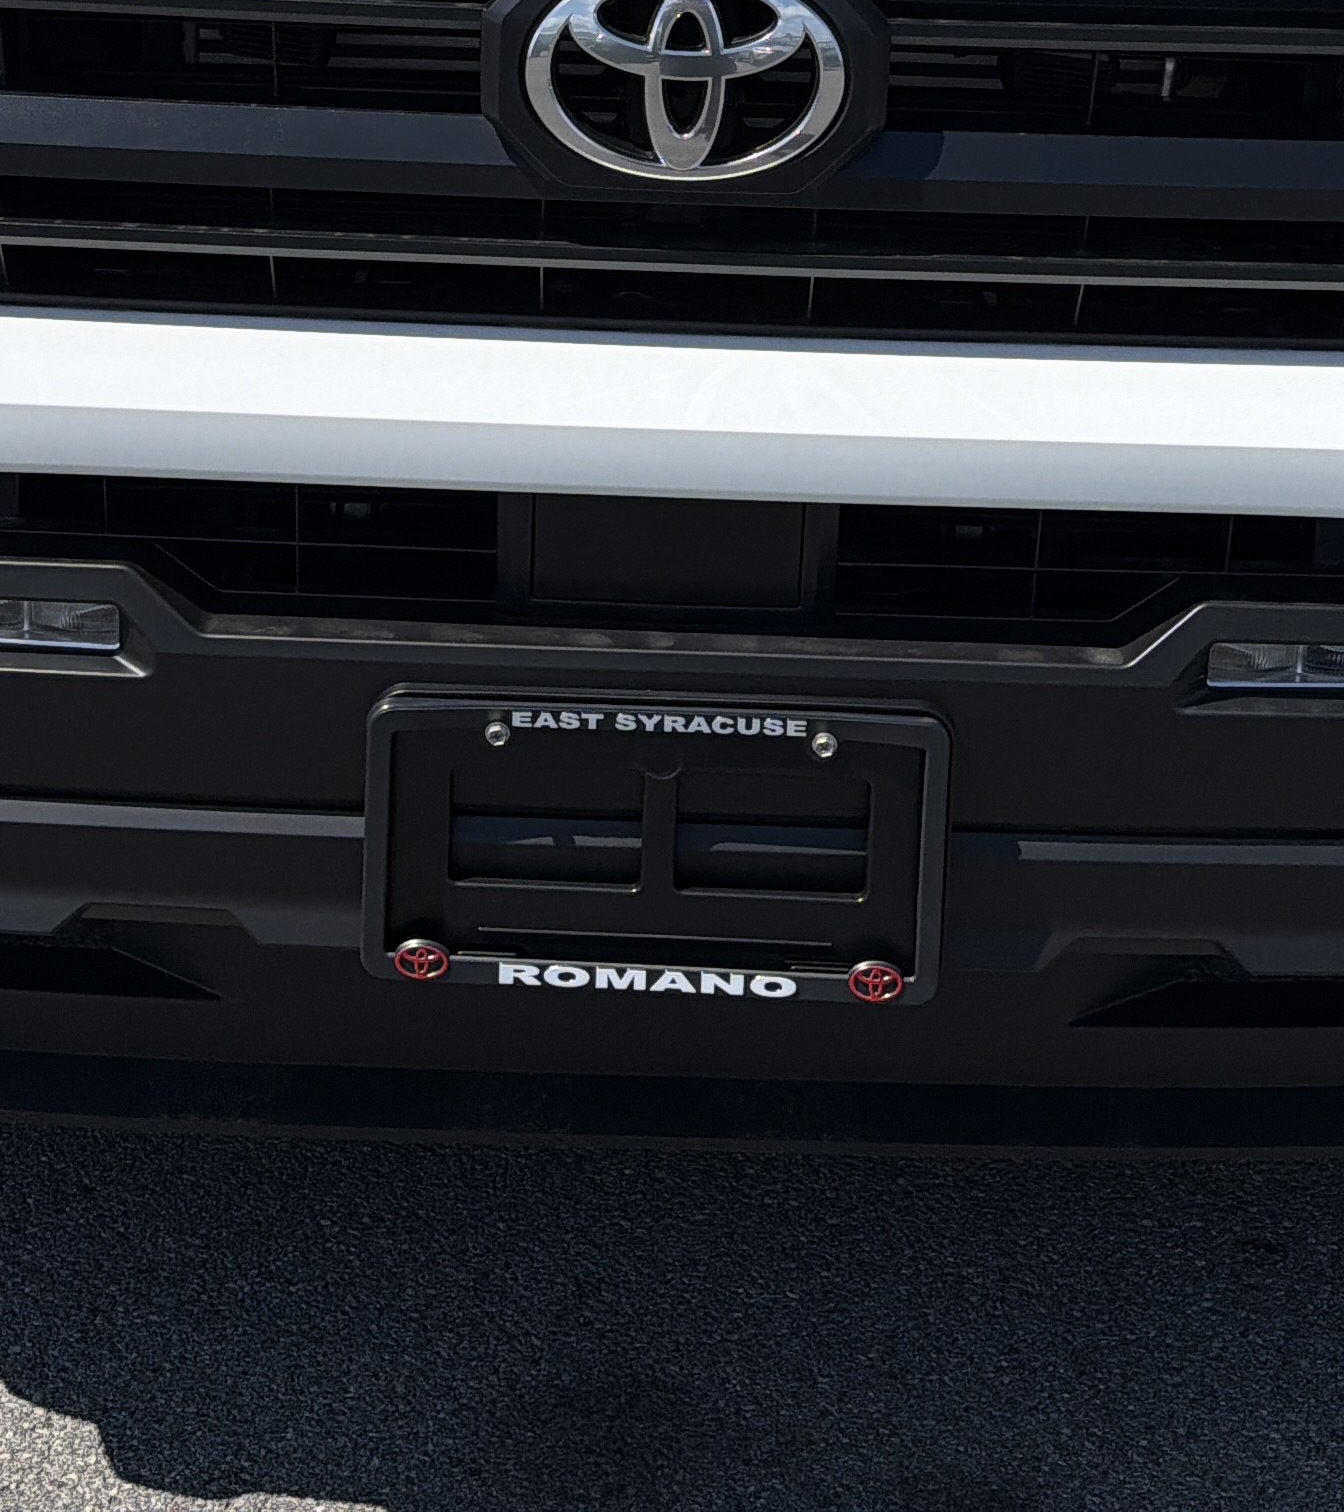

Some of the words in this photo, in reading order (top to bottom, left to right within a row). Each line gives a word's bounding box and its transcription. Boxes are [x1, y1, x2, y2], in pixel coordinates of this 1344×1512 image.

[511, 710, 604, 730] EAST
[614, 711, 808, 737] SYRACUSE
[498, 961, 798, 999] ROMANO
